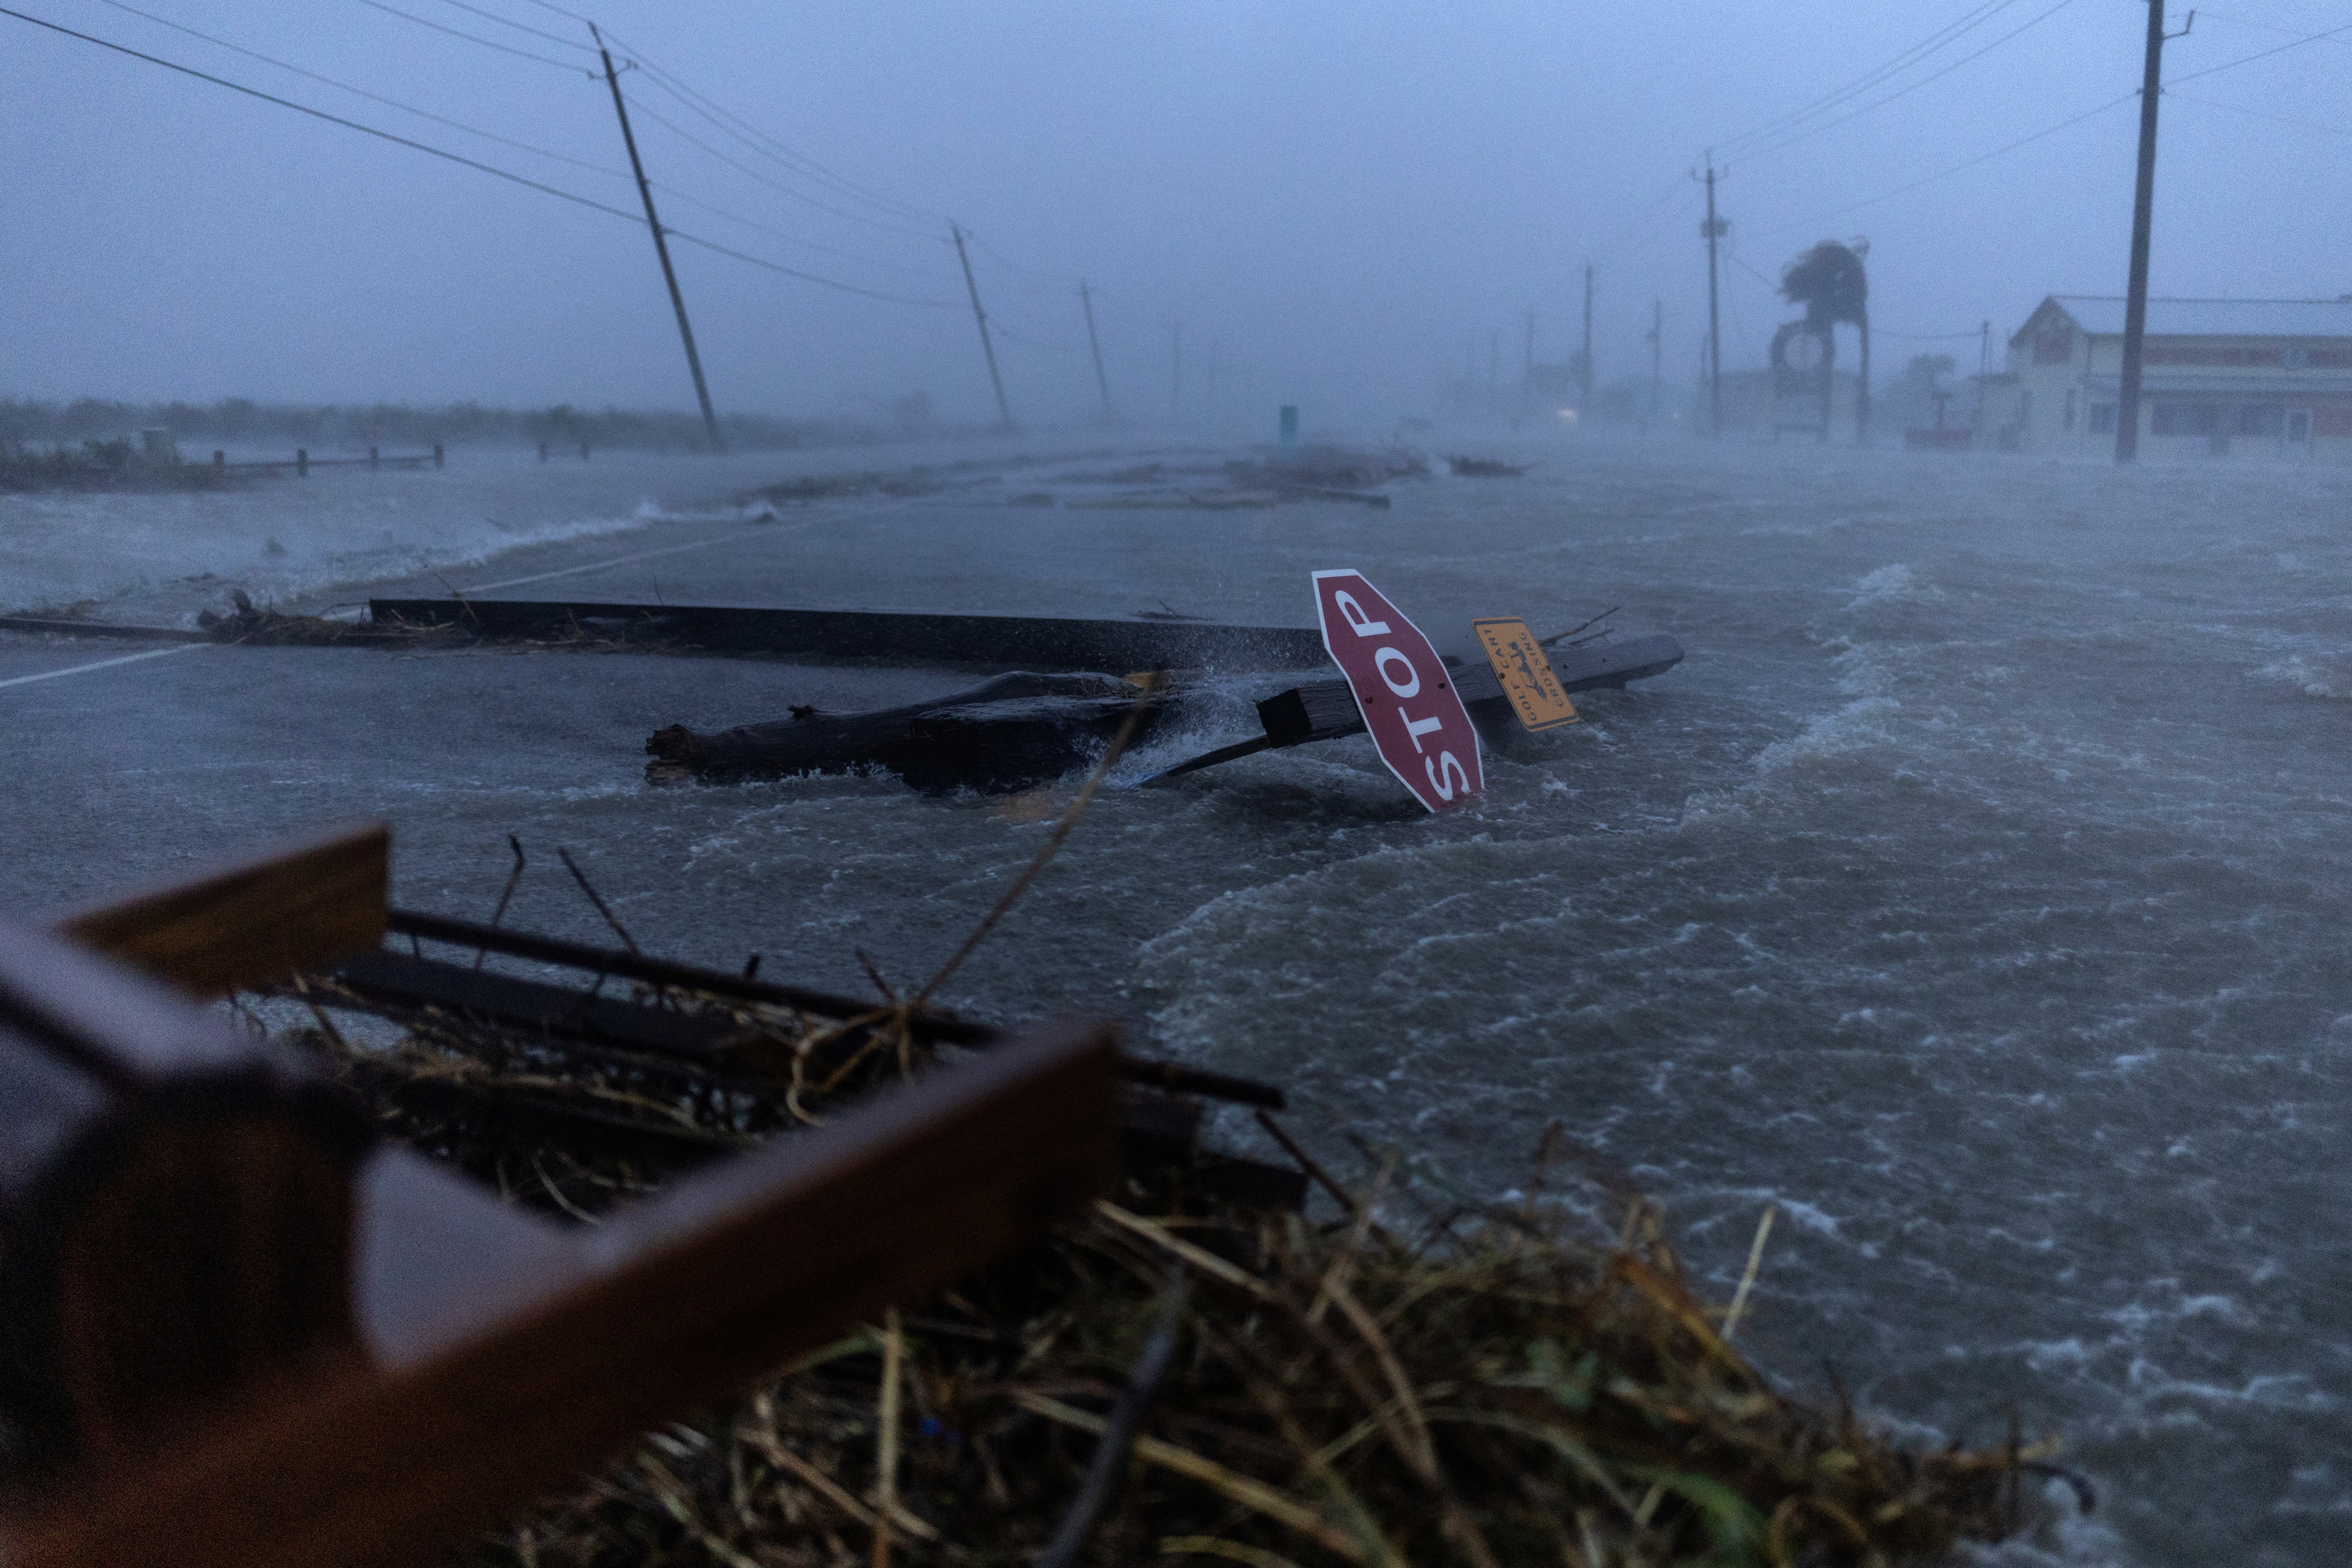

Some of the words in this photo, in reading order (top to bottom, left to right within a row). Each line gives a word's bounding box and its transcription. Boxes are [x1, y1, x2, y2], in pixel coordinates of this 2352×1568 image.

[1484, 629, 1509, 669] CART
[1518, 633, 1564, 707] CROSSING
[1335, 590, 1470, 801] STOP
[1511, 682, 1537, 721] GOLF
